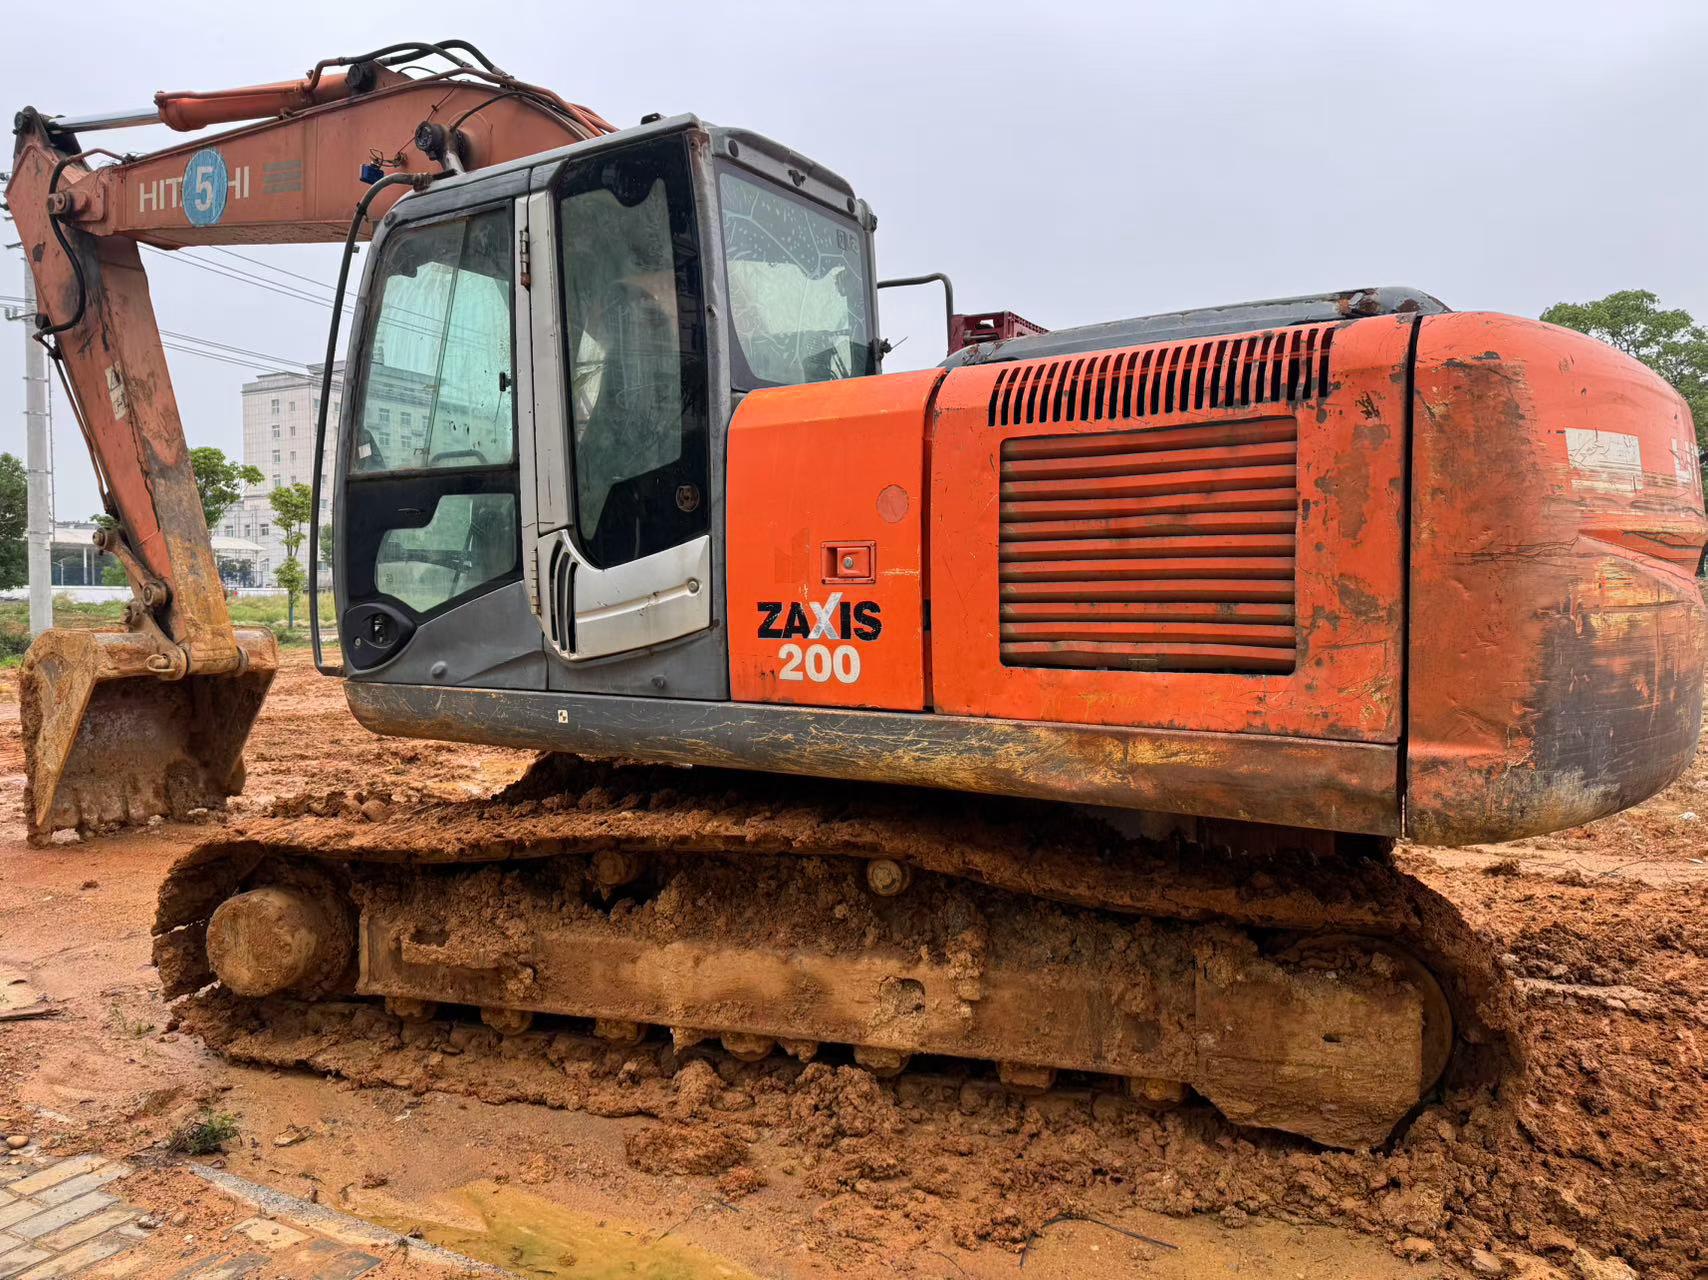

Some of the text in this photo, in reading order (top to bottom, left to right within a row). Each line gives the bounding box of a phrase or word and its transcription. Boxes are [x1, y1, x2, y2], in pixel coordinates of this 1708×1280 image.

[139, 166, 250, 213] HITHI
[194, 165, 215, 212] 5
[757, 592, 883, 641] ZAXIS
[778, 643, 861, 684] 200
